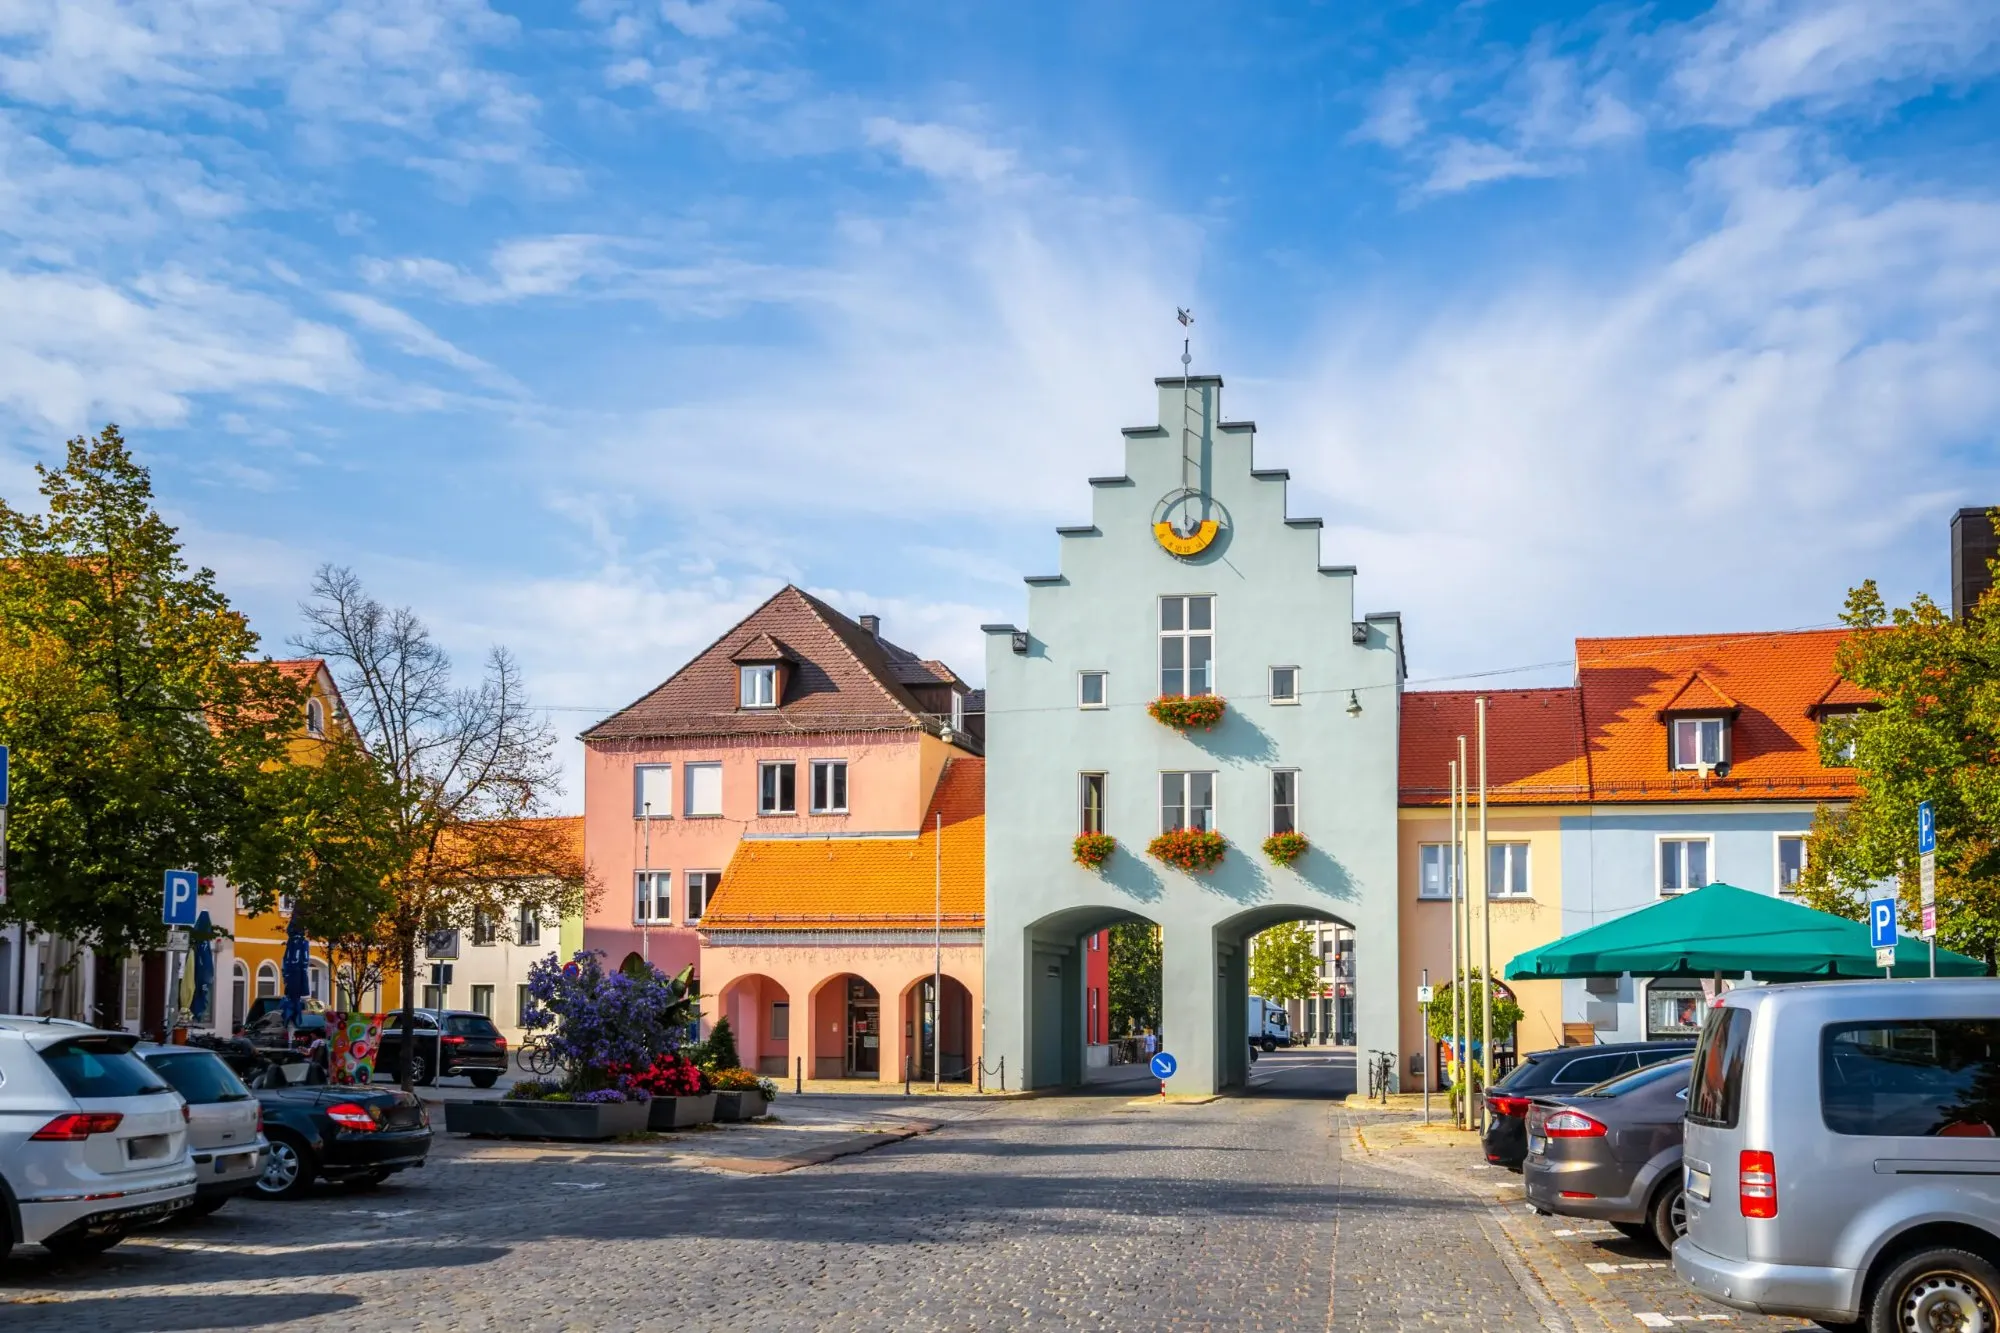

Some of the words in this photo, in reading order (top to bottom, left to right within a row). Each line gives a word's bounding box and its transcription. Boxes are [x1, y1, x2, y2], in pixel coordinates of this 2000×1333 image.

[1922, 808, 1931, 847] P
[171, 877, 190, 917] P
[1876, 905, 1891, 941] P
